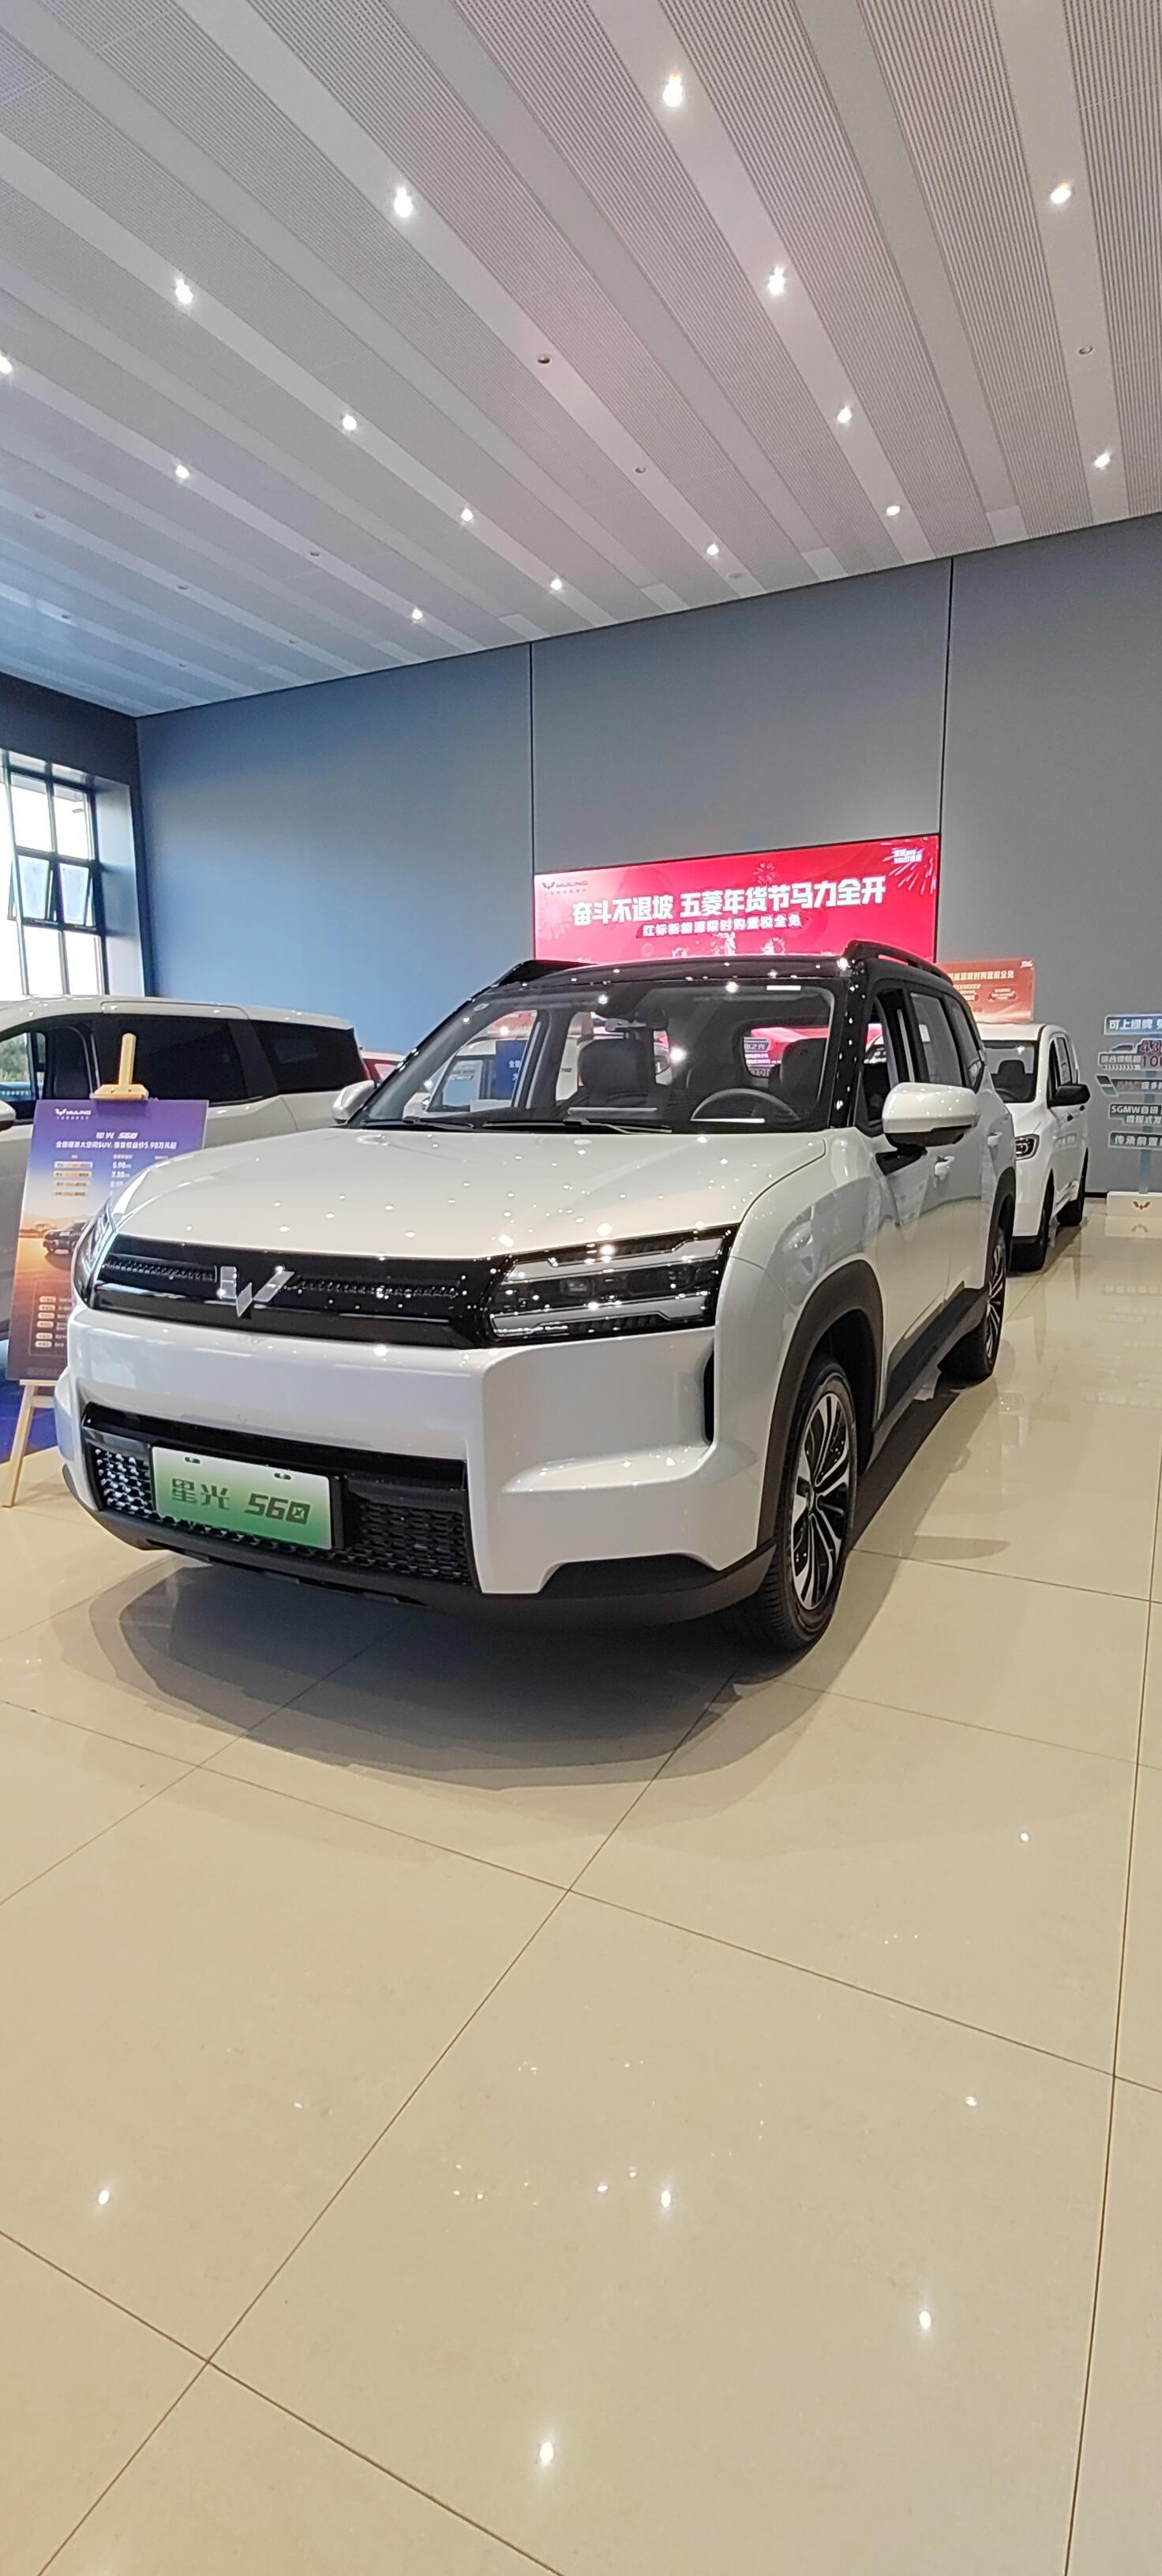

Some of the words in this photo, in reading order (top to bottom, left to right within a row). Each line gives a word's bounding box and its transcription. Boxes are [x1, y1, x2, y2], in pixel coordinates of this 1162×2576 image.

[572, 896, 673, 927] 奋斗不退坡
[680, 875, 886, 918] 五菱年货节马力全开
[642, 914, 802, 937] 红标新能源限时购置税全免
[171, 1477, 231, 1511] 星光
[244, 1492, 311, 1526] 560
